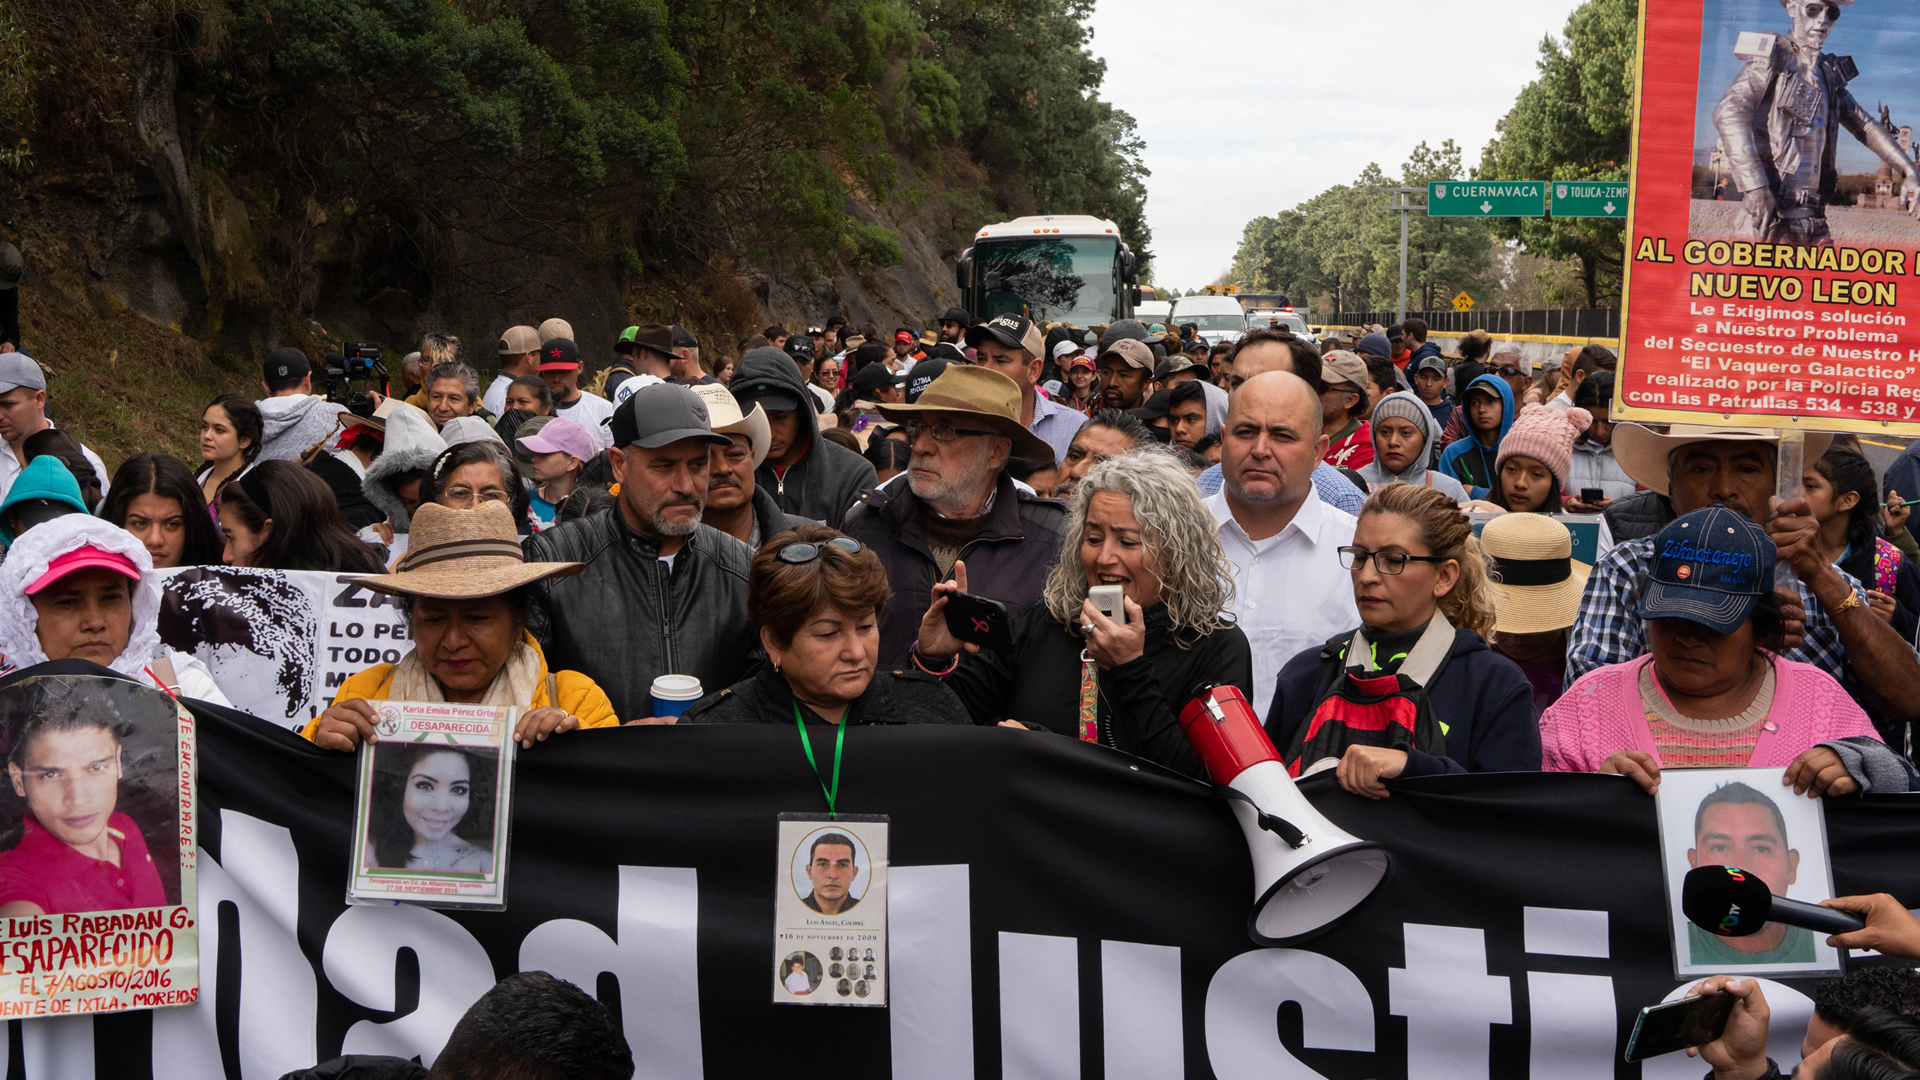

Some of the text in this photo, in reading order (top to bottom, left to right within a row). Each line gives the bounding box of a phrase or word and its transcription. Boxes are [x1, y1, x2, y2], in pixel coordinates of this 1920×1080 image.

[1452, 186, 1538, 198] CUERNAVACA
[1635, 237, 1675, 263] AL
[1683, 240, 1906, 275] GOBERNADOR
[1690, 272, 1897, 306] NUEVO LEON
[1690, 302, 1906, 326] Le Exigimos solución
[1696, 322, 1898, 343] a Nuestro Problema
[1644, 336, 1674, 350] del
[1680, 338, 1785, 356] Secuestro
[1791, 343, 1816, 357] de
[1822, 345, 1903, 362] Nuestro
[1719, 358, 1808, 376] Vaquero
[1647, 373, 1740, 390] realizado
[1746, 380, 1779, 394] por
[1785, 379, 1803, 392] la
[1810, 380, 1879, 398] Policia
[1629, 392, 1665, 405] con
[1672, 390, 1702, 406] las
[1709, 393, 1800, 411] Patrullas
[1805, 397, 1842, 412] 534
[1860, 400, 1897, 416] 538
[1903, 404, 1916, 418] y
[329, 621, 365, 639] LO
[326, 646, 402, 665] TODO
[403, 705, 505, 719] Karla Emilia Pérez Ortega
[410, 720, 490, 733] DESAPARECIDA
[63, 909, 163, 935] RABADAN
[19, 976, 41, 996] EL
